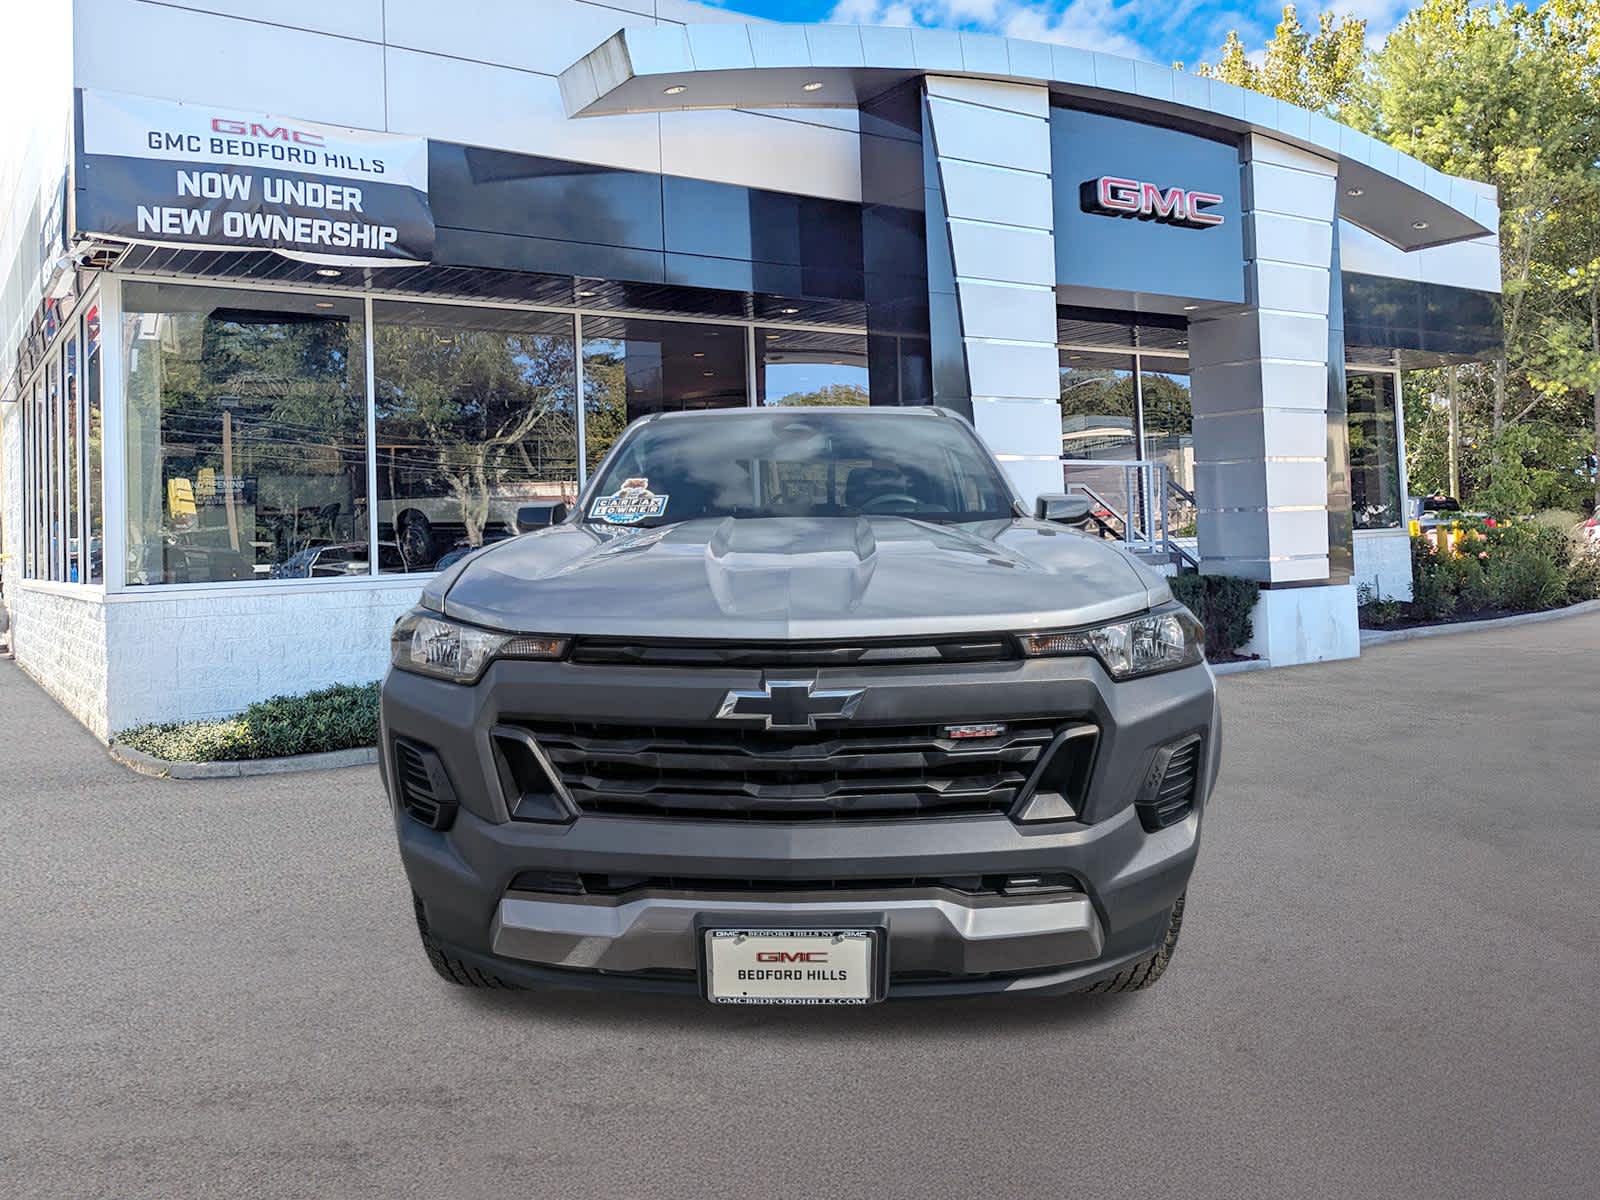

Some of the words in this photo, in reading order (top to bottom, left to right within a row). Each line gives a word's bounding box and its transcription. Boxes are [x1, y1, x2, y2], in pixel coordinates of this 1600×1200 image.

[211, 118, 325, 147] GMC
[148, 131, 200, 152] GMC
[210, 138, 317, 166] BEDFORD
[325, 154, 385, 173] HILLS
[176, 170, 252, 201] NOW
[264, 176, 364, 213] UNDER
[1097, 176, 1225, 224] GMC
[136, 205, 211, 236] NEW
[223, 211, 398, 250] OWNERSHIP
[600, 498, 661, 506] CARFAX
[757, 952, 828, 963] GMC
[738, 970, 802, 980] BEDFORD
[807, 970, 847, 980] HILLS
[717, 997, 866, 1005] GMCBEDFORDHILLS.COM
